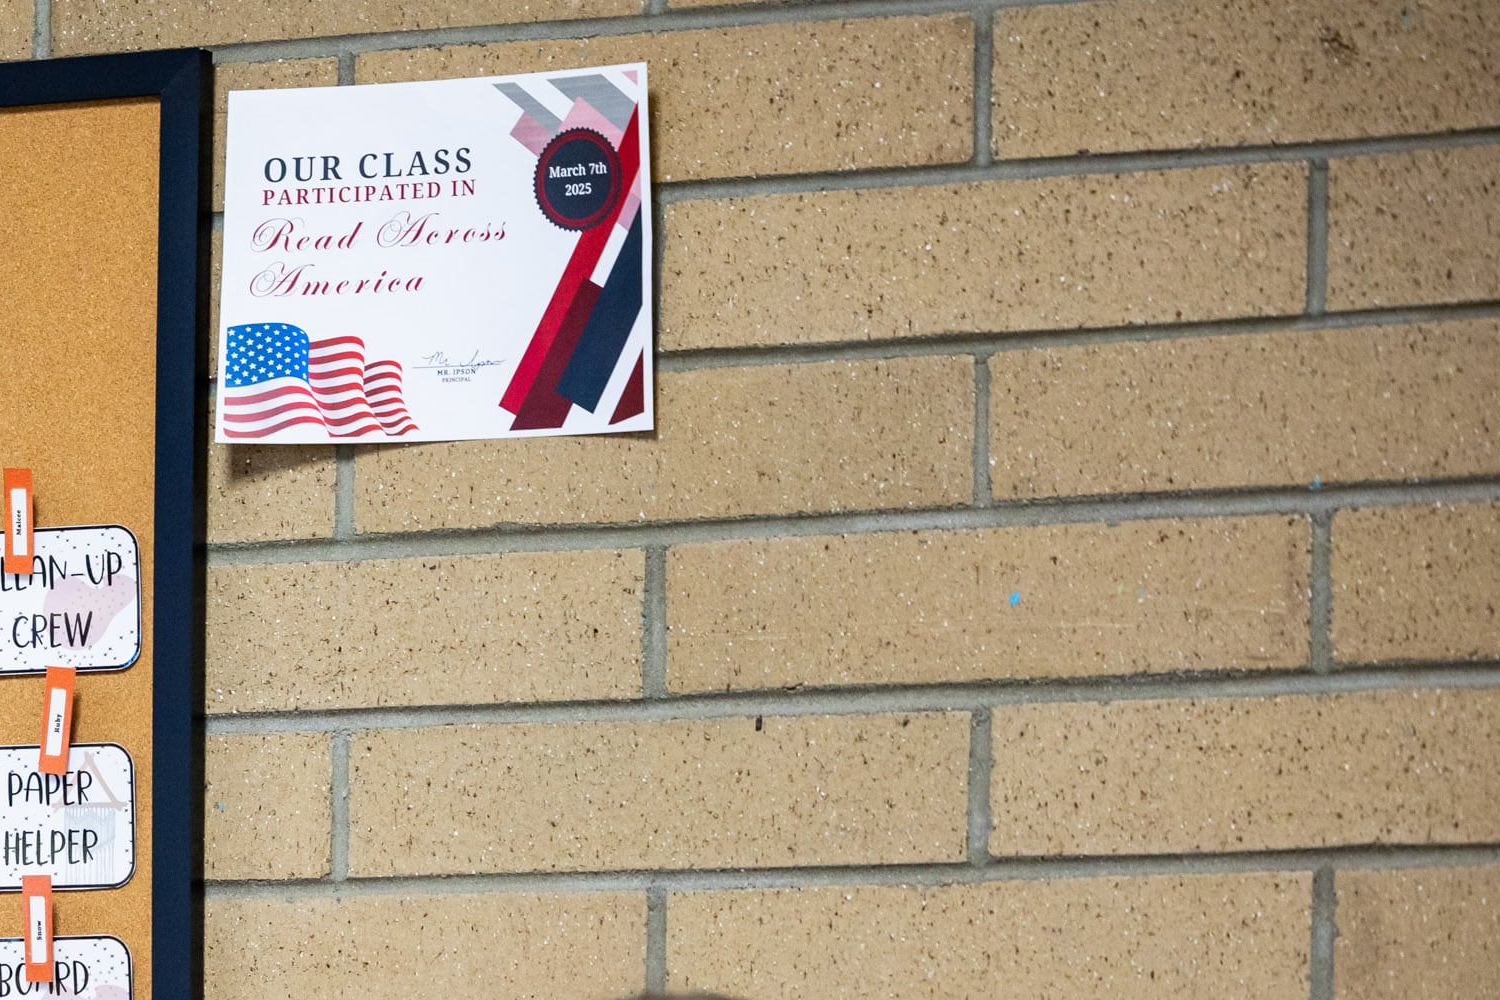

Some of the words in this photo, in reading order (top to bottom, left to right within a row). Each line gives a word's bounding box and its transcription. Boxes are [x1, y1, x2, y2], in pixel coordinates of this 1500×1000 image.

[264, 155, 342, 183] OUR
[359, 148, 471, 179] CLASS
[549, 163, 586, 178] March
[589, 162, 607, 175] 7th
[262, 182, 440, 206] PARTICIPATED
[451, 179, 476, 197] IN
[565, 182, 592, 196] 2025
[251, 217, 363, 253] Read
[377, 211, 506, 248] Across
[250, 261, 424, 298] America
[12, 611, 92, 649] CREW
[55, 713, 63, 734] Ruby
[8, 770, 92, 808] PAPER
[4, 828, 98, 866] HELPER
